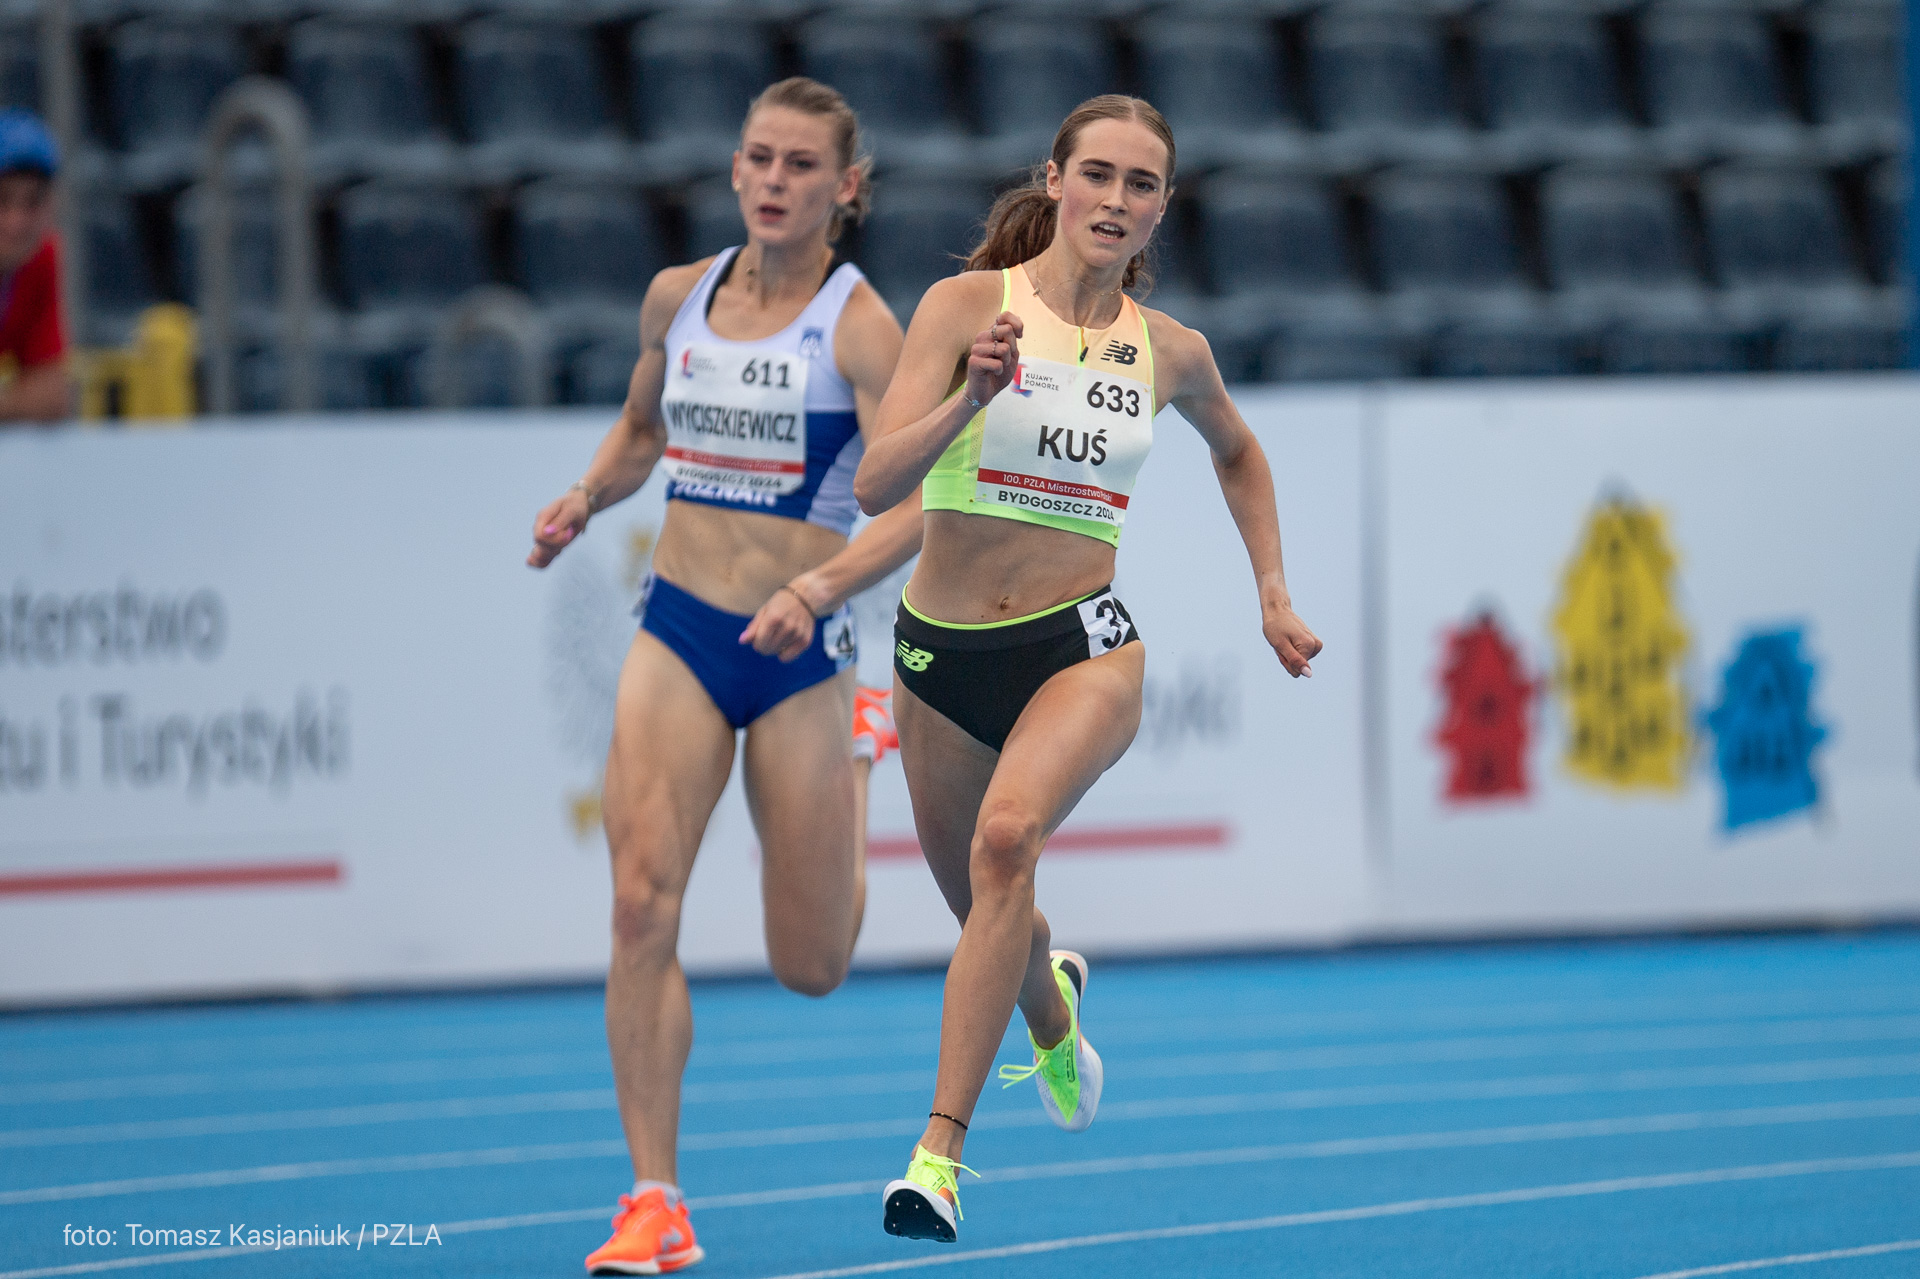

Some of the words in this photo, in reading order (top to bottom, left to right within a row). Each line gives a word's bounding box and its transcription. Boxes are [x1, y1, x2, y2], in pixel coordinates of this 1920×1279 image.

[741, 357, 790, 388] 611
[1024, 379, 1060, 392] POMORZE
[1025, 372, 1053, 382] KUJAWY
[1087, 381, 1140, 418] 633
[667, 401, 796, 443] WYCISZKIEWICZ
[1037, 424, 1108, 467] KUŚ
[1003, 473, 1022, 485] 100.
[1023, 477, 1046, 489] PZLA
[997, 490, 1093, 516] BYDGOSZCZ
[1095, 506, 1115, 521] 2024
[1096, 599, 1122, 649] 3
